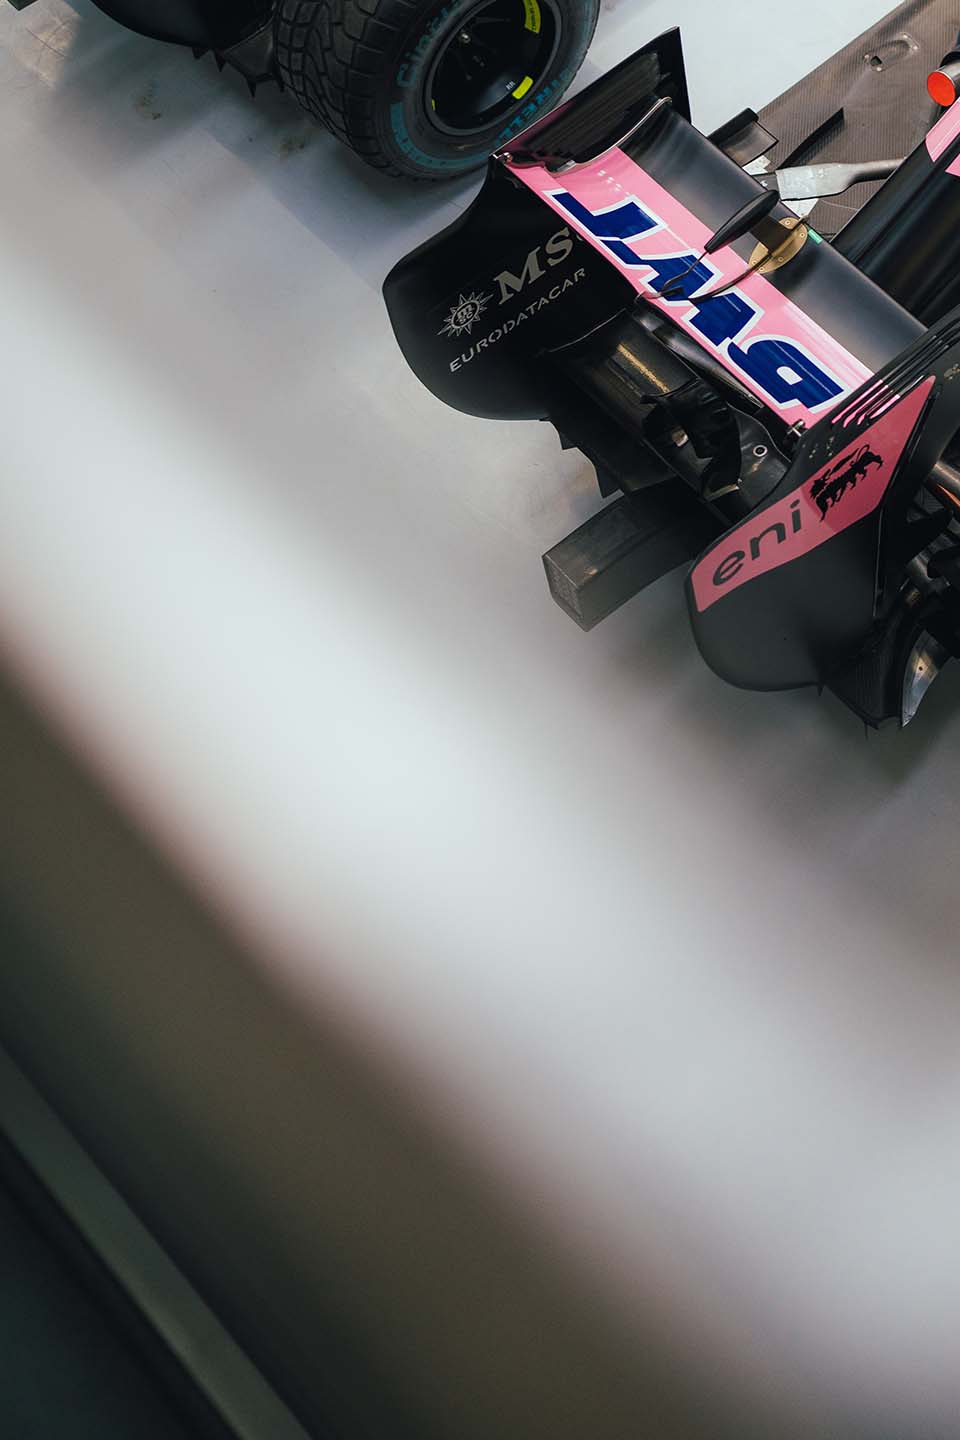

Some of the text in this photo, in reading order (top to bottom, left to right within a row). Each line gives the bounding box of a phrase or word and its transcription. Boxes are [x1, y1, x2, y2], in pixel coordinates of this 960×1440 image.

[495, 227, 582, 305] MS
[547, 190, 854, 412] BWT
[450, 267, 586, 373] EURODATACAR
[712, 501, 801, 586] eni
